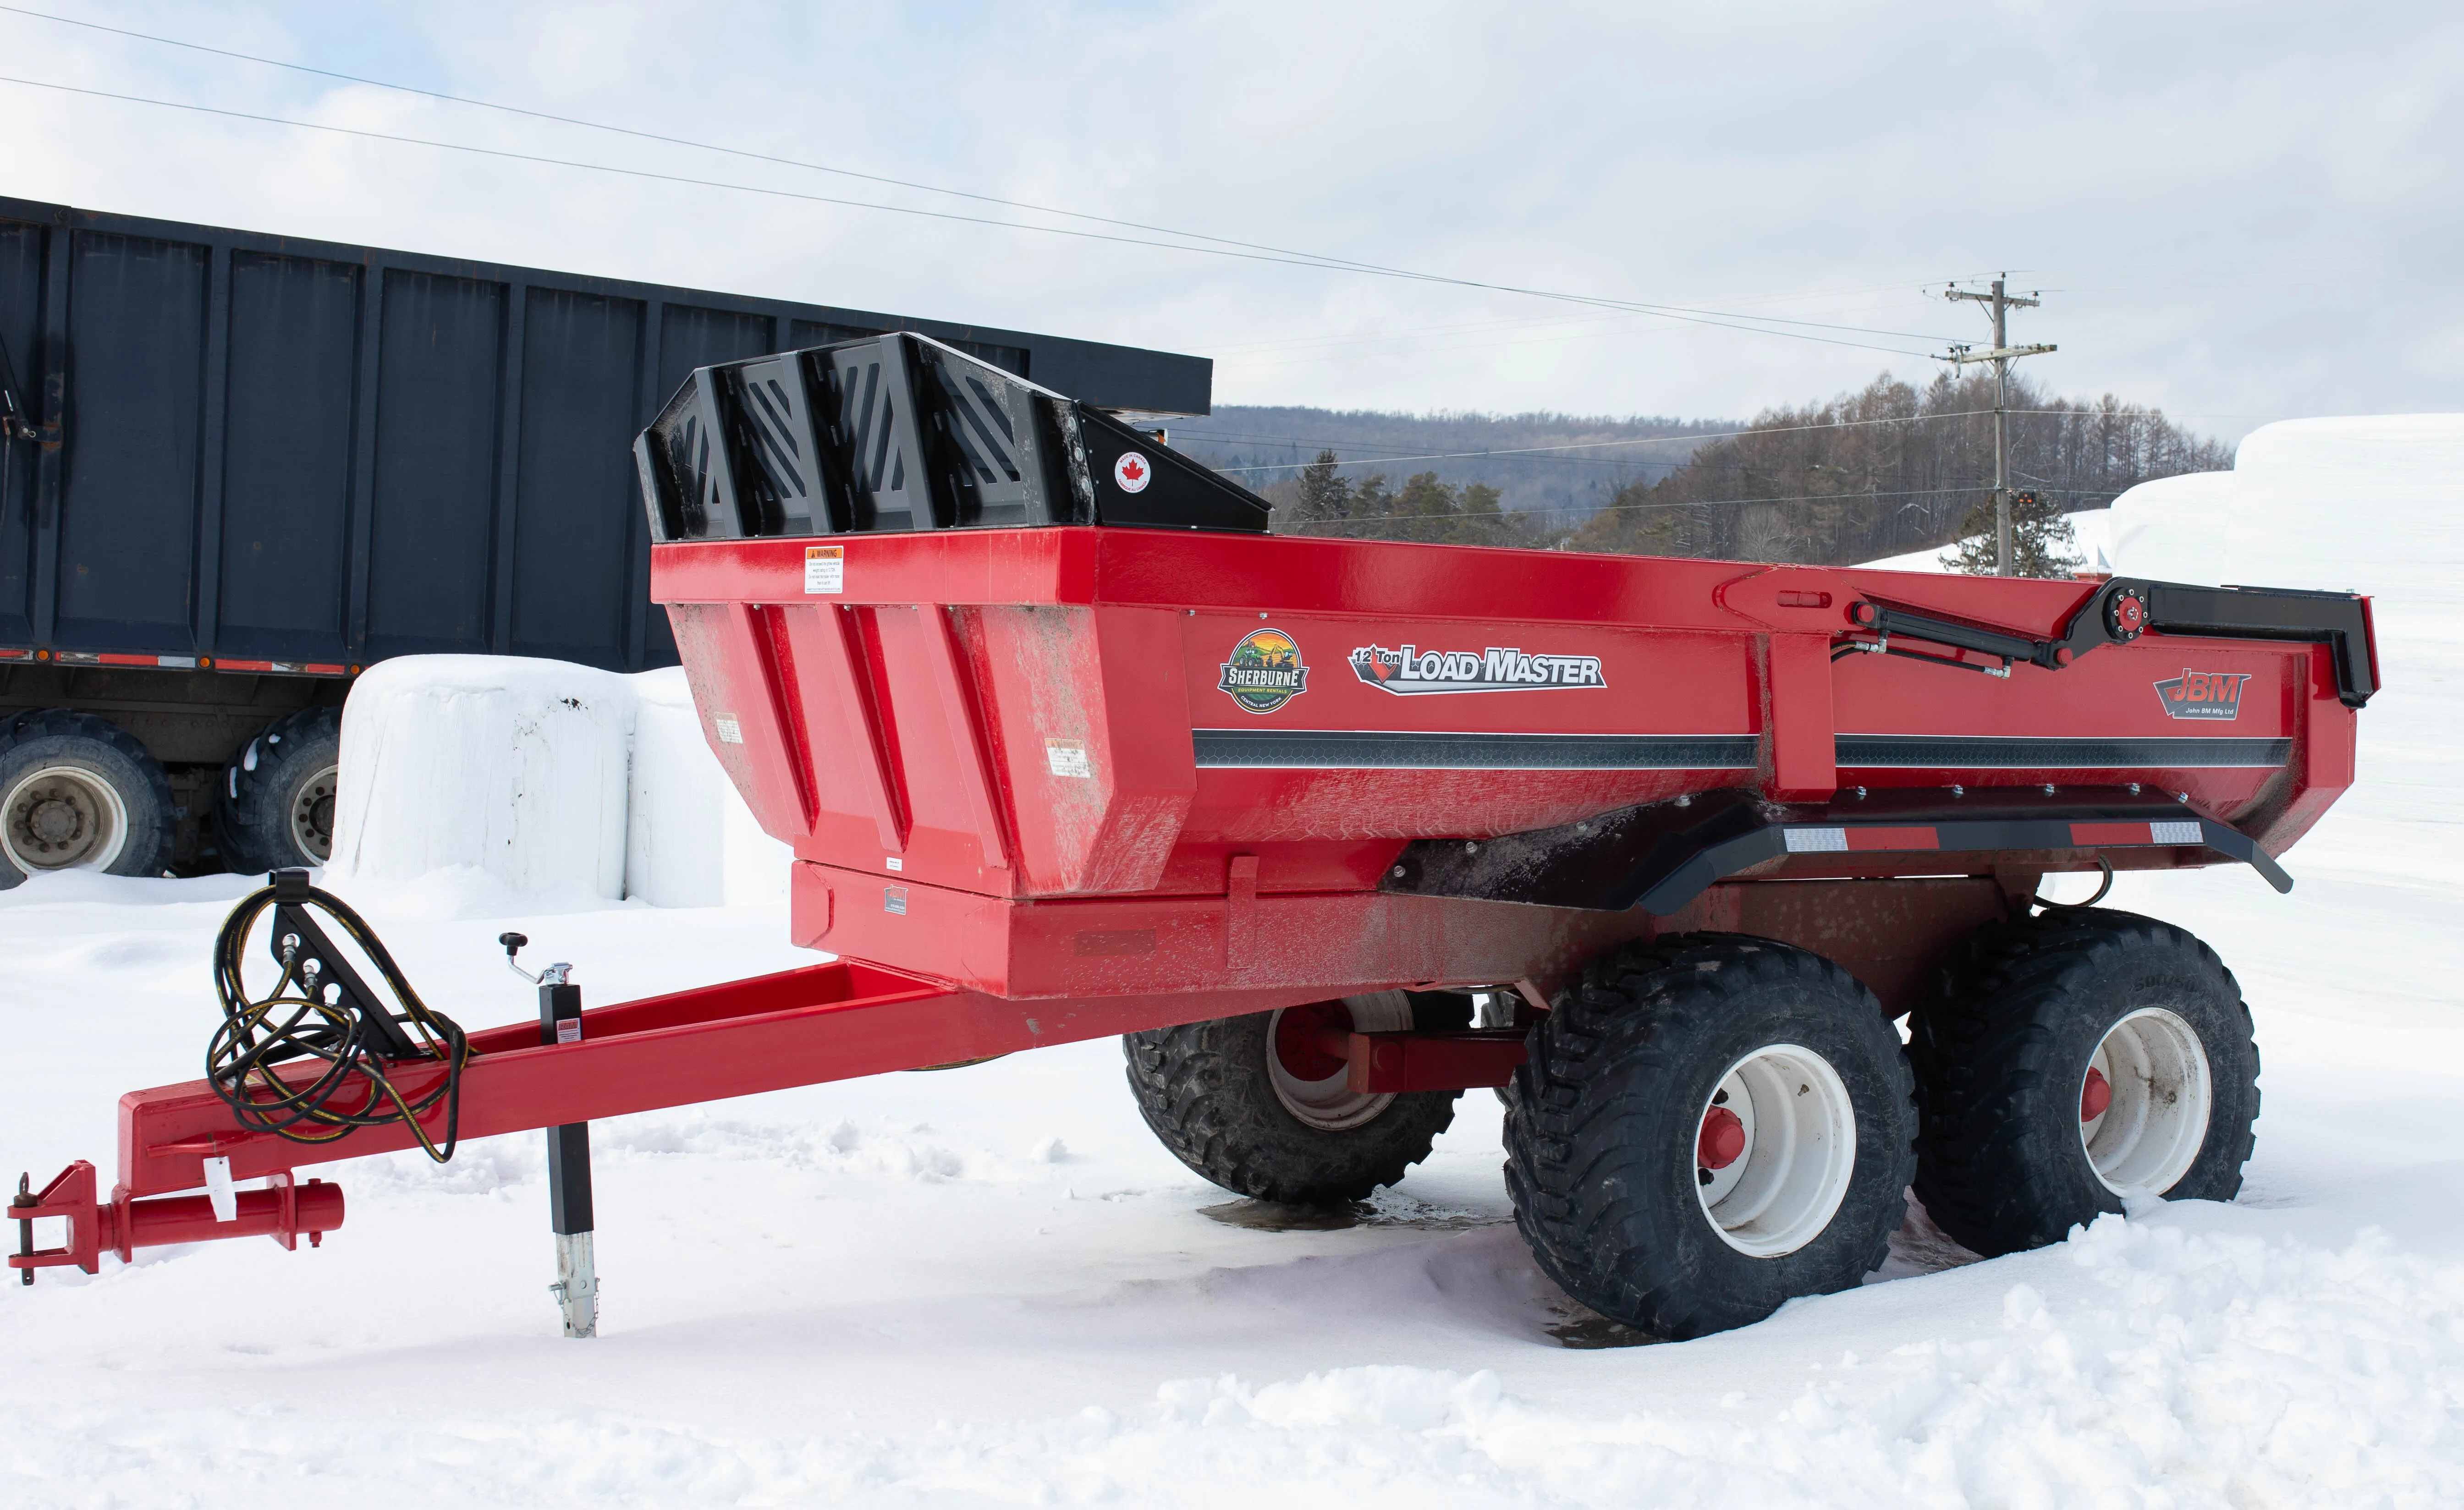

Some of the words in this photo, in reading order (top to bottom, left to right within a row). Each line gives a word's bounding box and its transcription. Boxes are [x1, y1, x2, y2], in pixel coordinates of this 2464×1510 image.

[1133, 454, 1146, 465] CANADA
[1137, 481, 1147, 490] CANADA
[1355, 650, 1371, 662] 12
[1377, 651, 1400, 663] Ton
[1401, 647, 1479, 681] LOAD
[1484, 649, 1598, 684] MASTER
[1229, 668, 1299, 686] SHERBURNE
[2174, 670, 2239, 703] JBM
[1241, 696, 1258, 707] CENTRAL
[1270, 697, 1282, 705] YORK
[558, 1021, 578, 1031] RAM
